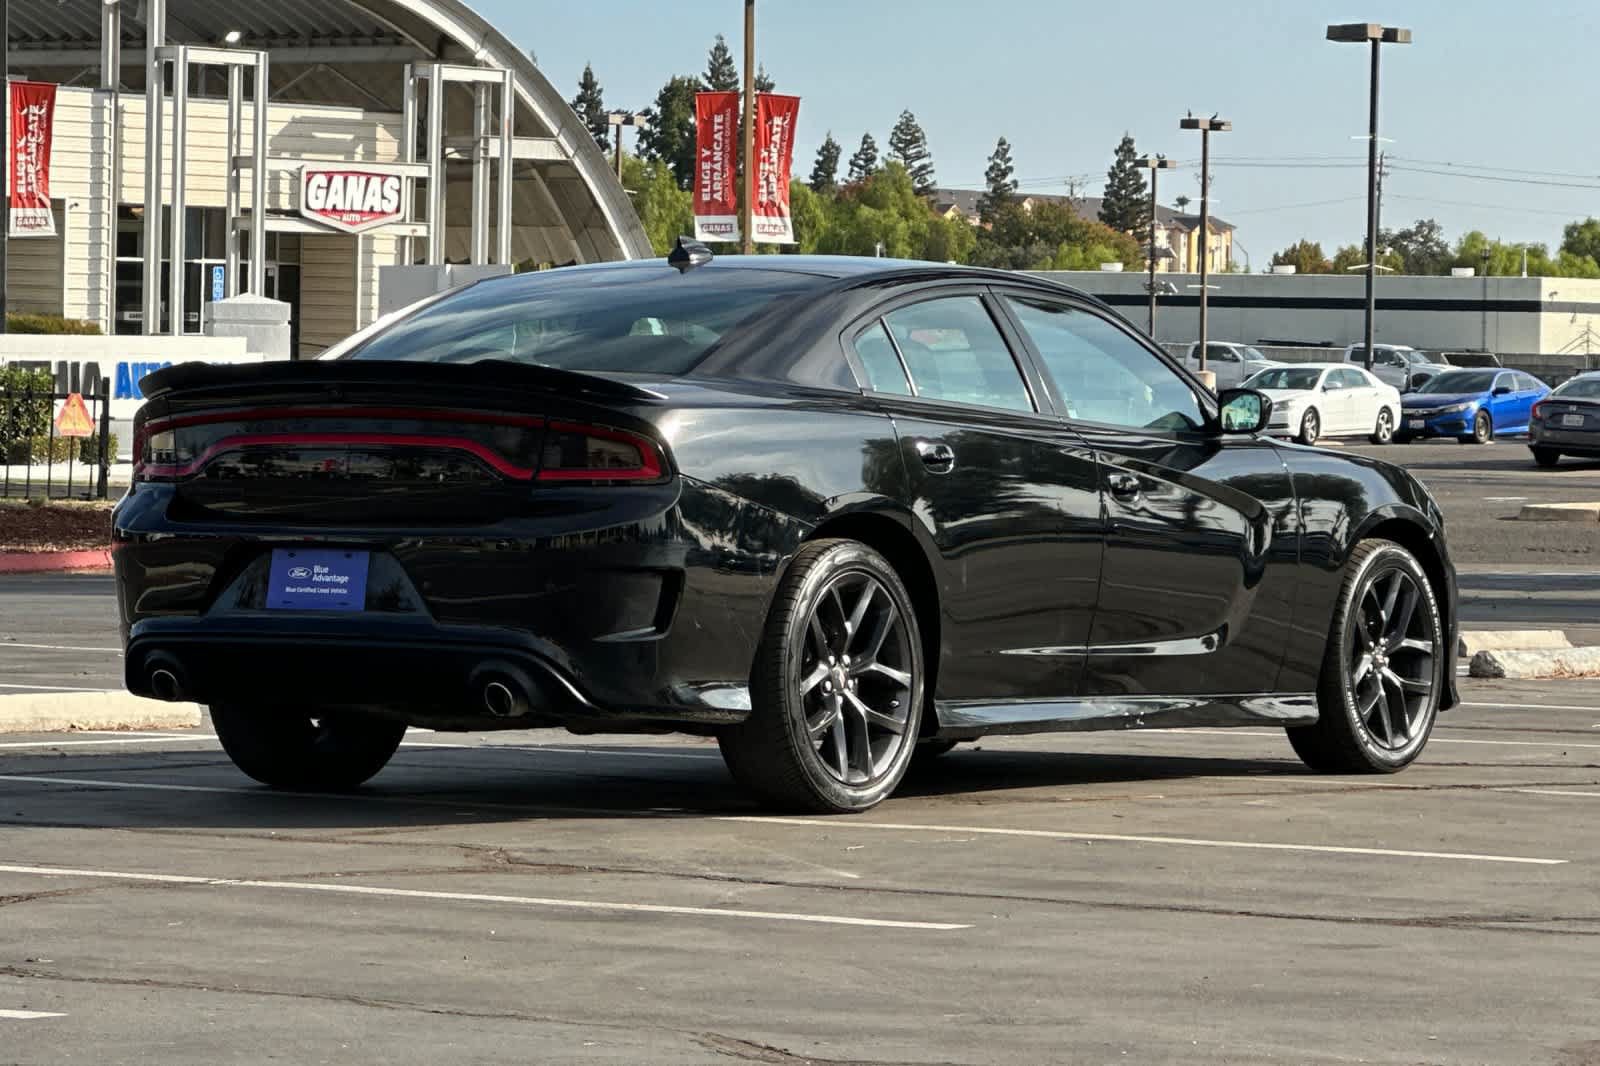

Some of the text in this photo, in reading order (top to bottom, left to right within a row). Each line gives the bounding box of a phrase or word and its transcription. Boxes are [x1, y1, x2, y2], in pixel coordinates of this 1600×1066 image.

[701, 147, 711, 201] ELIGE Y
[308, 173, 400, 214] GANAS
[17, 216, 46, 226] GANAS
[342, 214, 361, 222] AUTO
[702, 224, 732, 233] GANAS
[313, 565, 329, 574] Blue
[312, 574, 349, 584] Advantage
